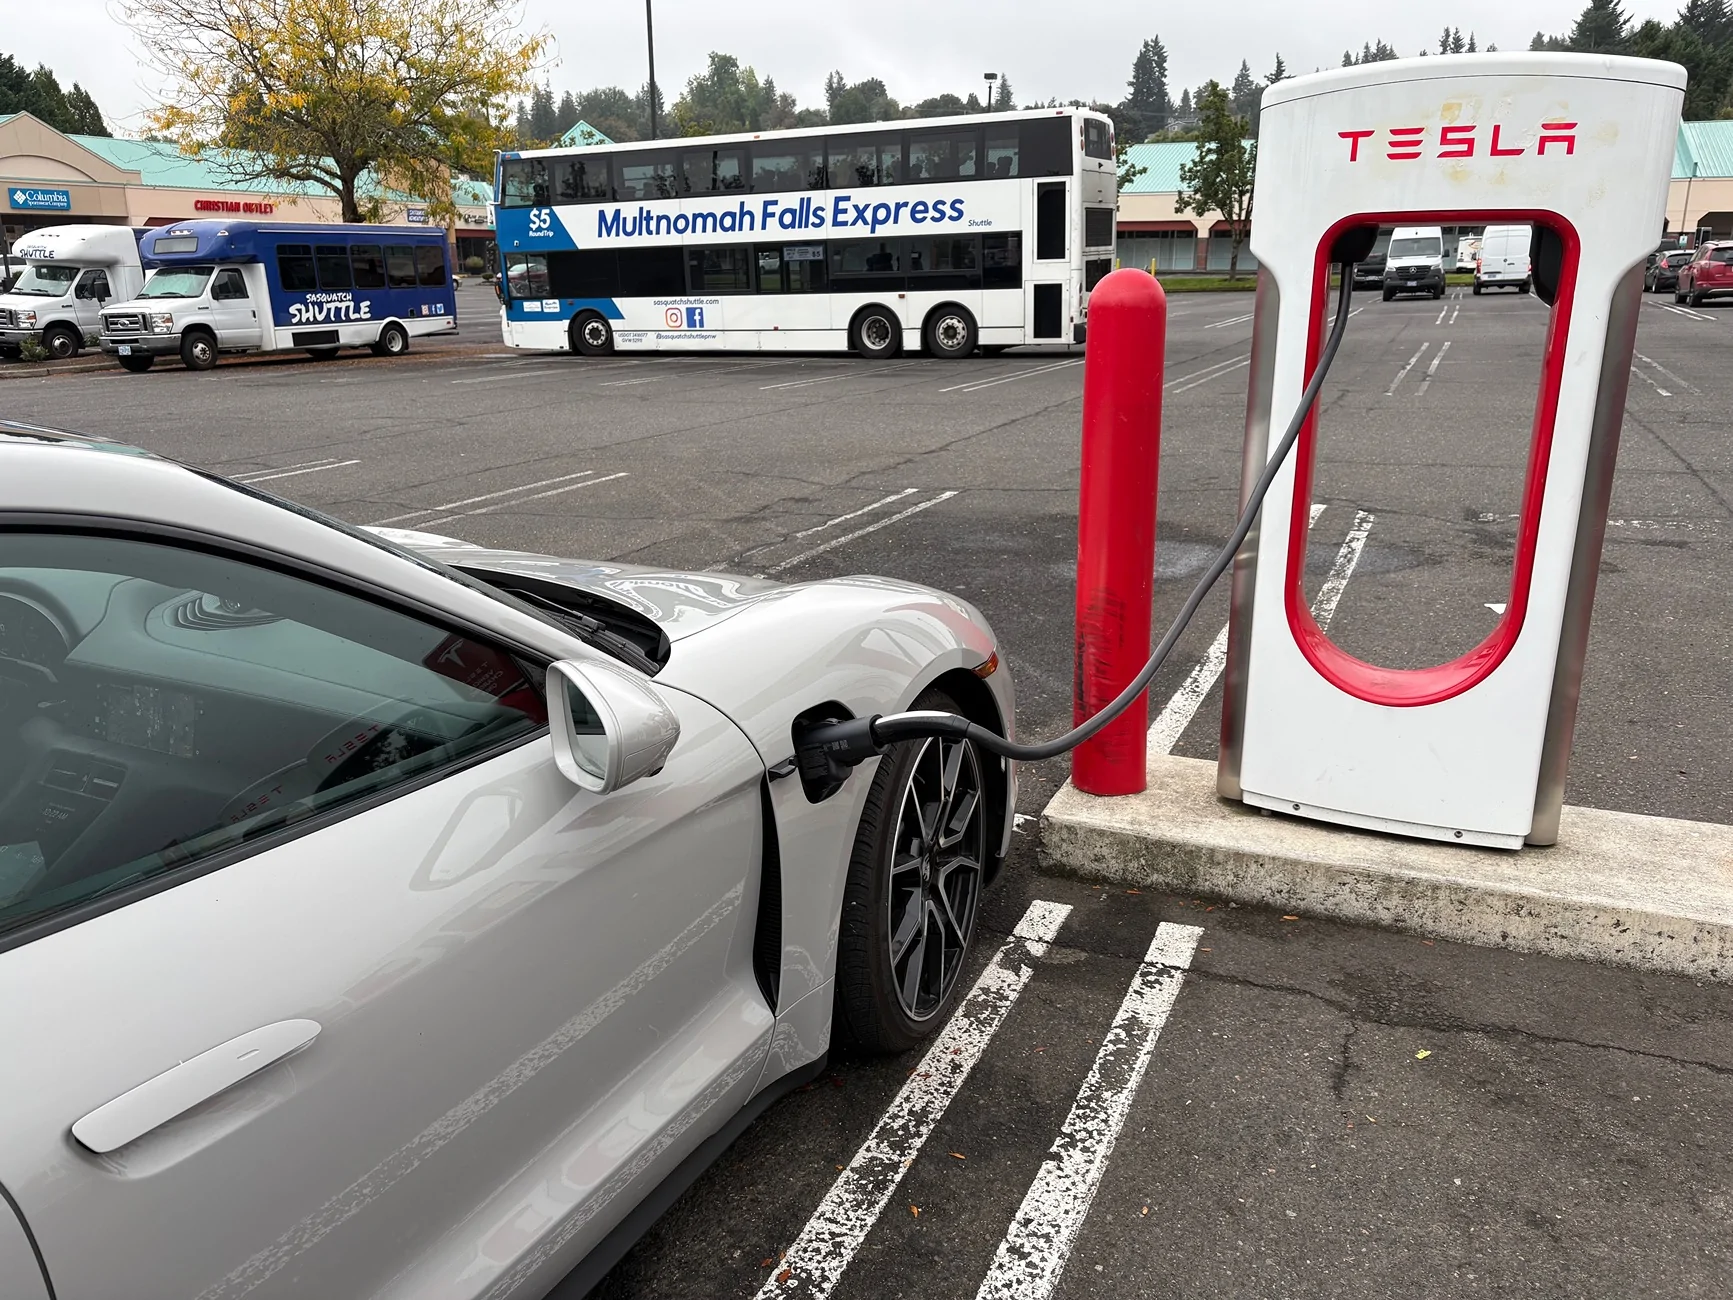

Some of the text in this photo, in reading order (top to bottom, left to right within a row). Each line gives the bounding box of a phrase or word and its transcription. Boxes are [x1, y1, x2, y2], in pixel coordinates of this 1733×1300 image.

[1337, 122, 1579, 163] TESLA
[26, 190, 68, 202] Columbia
[194, 200, 241, 213] CHRISTIAN
[529, 207, 551, 231] $5
[597, 195, 964, 238] Multnomah Falls Express
[968, 218, 993, 227] Shuttle
[20, 249, 55, 259] SHUTTLE
[306, 292, 353, 303] SASQUATCH
[653, 298, 720, 307] sasquatchshuttle.com
[289, 300, 372, 324] SHUTTLE
